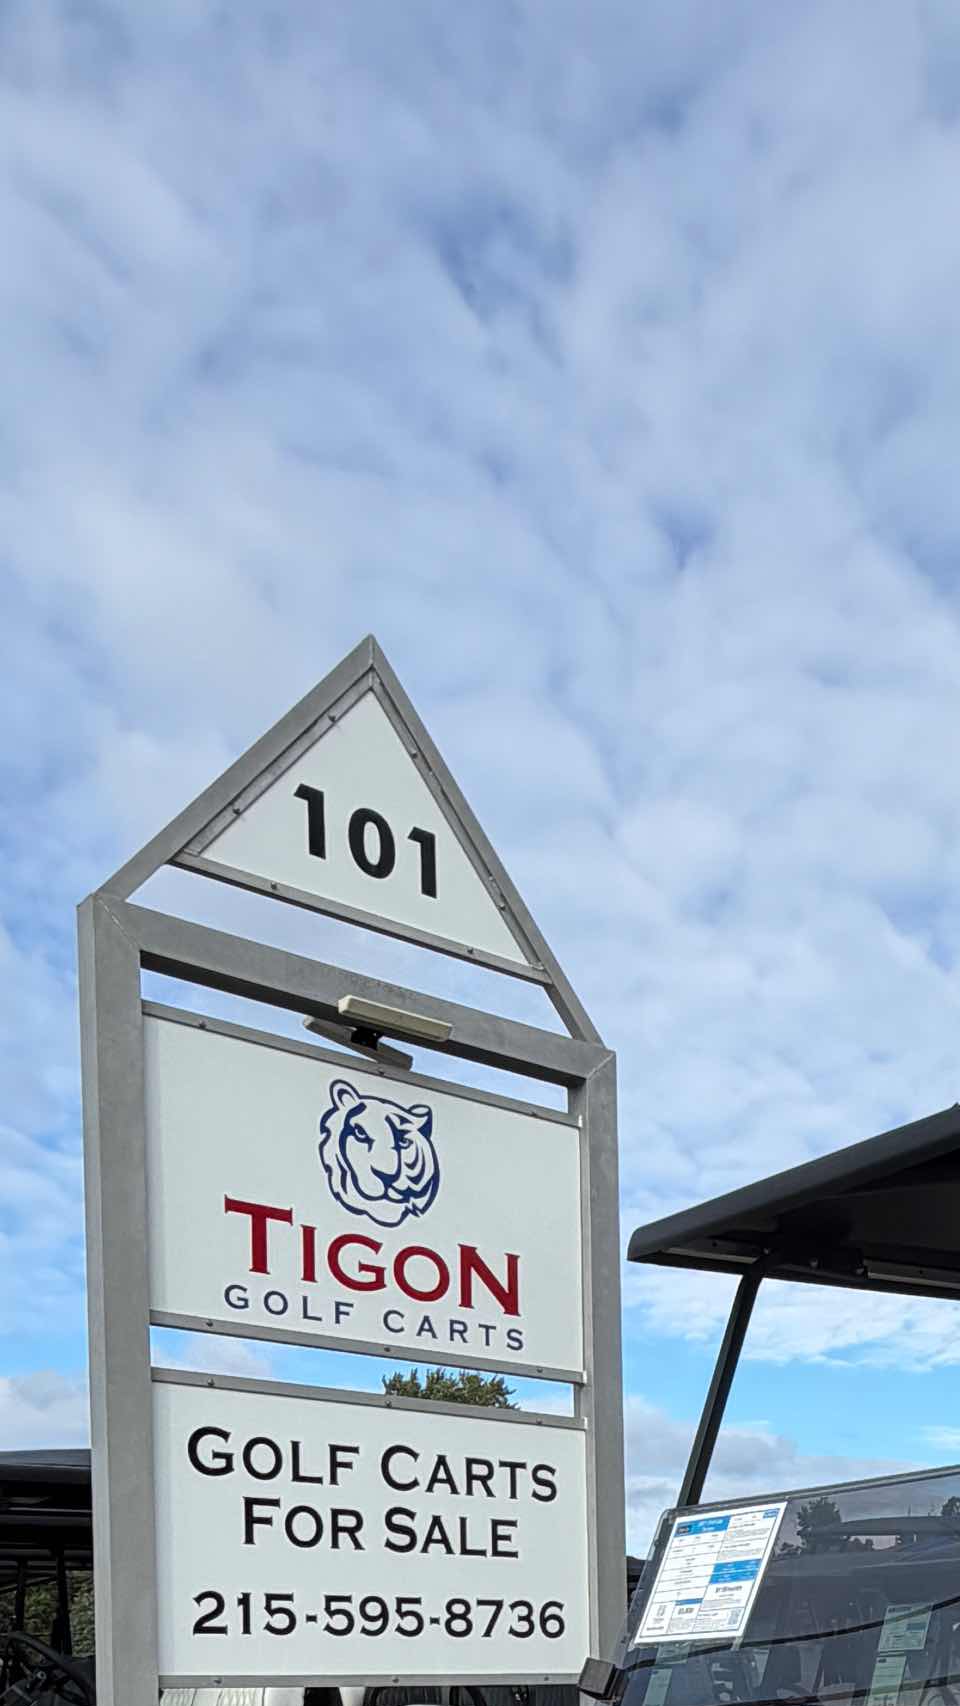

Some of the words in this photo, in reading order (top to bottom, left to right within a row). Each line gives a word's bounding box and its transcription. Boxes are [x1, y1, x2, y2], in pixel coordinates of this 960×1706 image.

[293, 783, 438, 900] 101
[224, 1194, 521, 1317] TIGON
[224, 1284, 354, 1325] GOLF
[382, 1309, 525, 1351] CARTS
[187, 1425, 361, 1486] GOLF
[380, 1444, 559, 1502] CARTS
[242, 1496, 366, 1551] FOR
[384, 1506, 519, 1558] SALE
[192, 1590, 566, 1640] 215-595-8736
